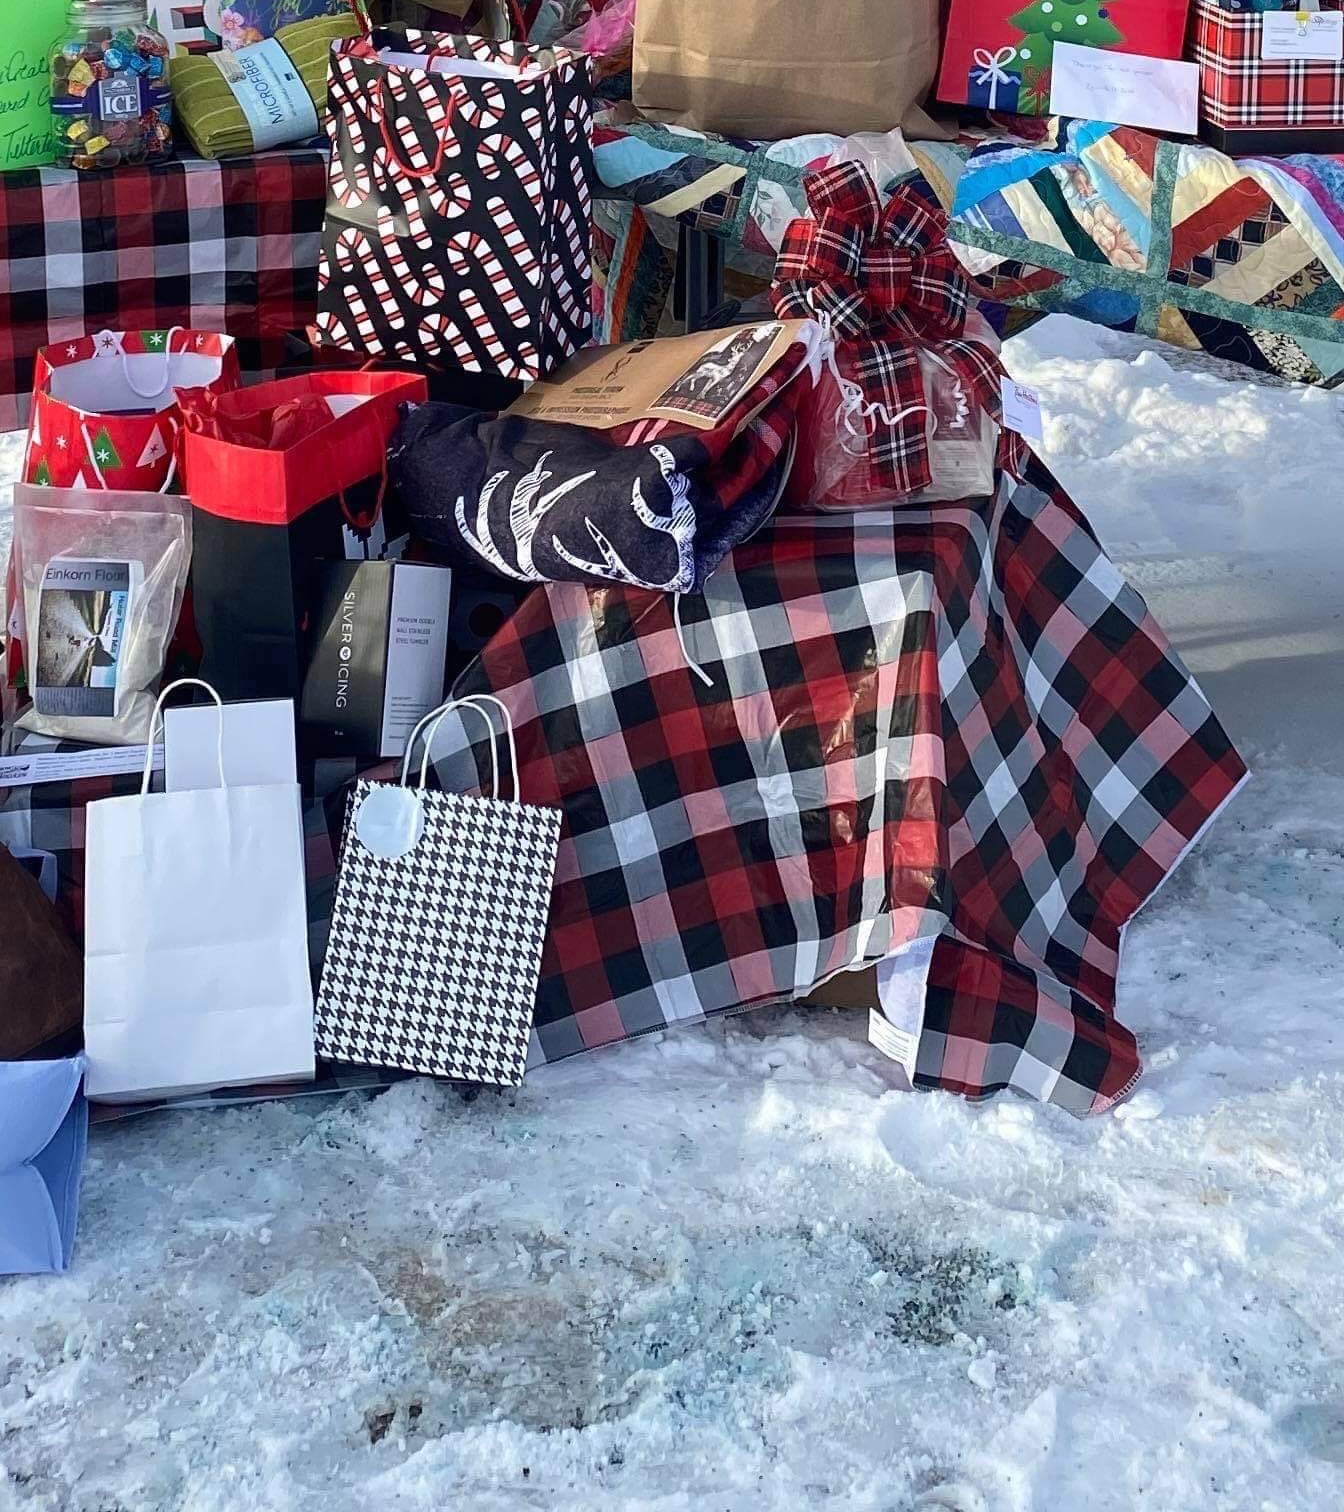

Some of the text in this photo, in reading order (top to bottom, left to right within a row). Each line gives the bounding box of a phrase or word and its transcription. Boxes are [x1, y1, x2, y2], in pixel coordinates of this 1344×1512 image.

[104, 94, 138, 114] ICE
[239, 56, 284, 125] MICROFIBER
[46, 568, 126, 582] Einkorn Flour
[336, 591, 356, 709] SILVER ICING
